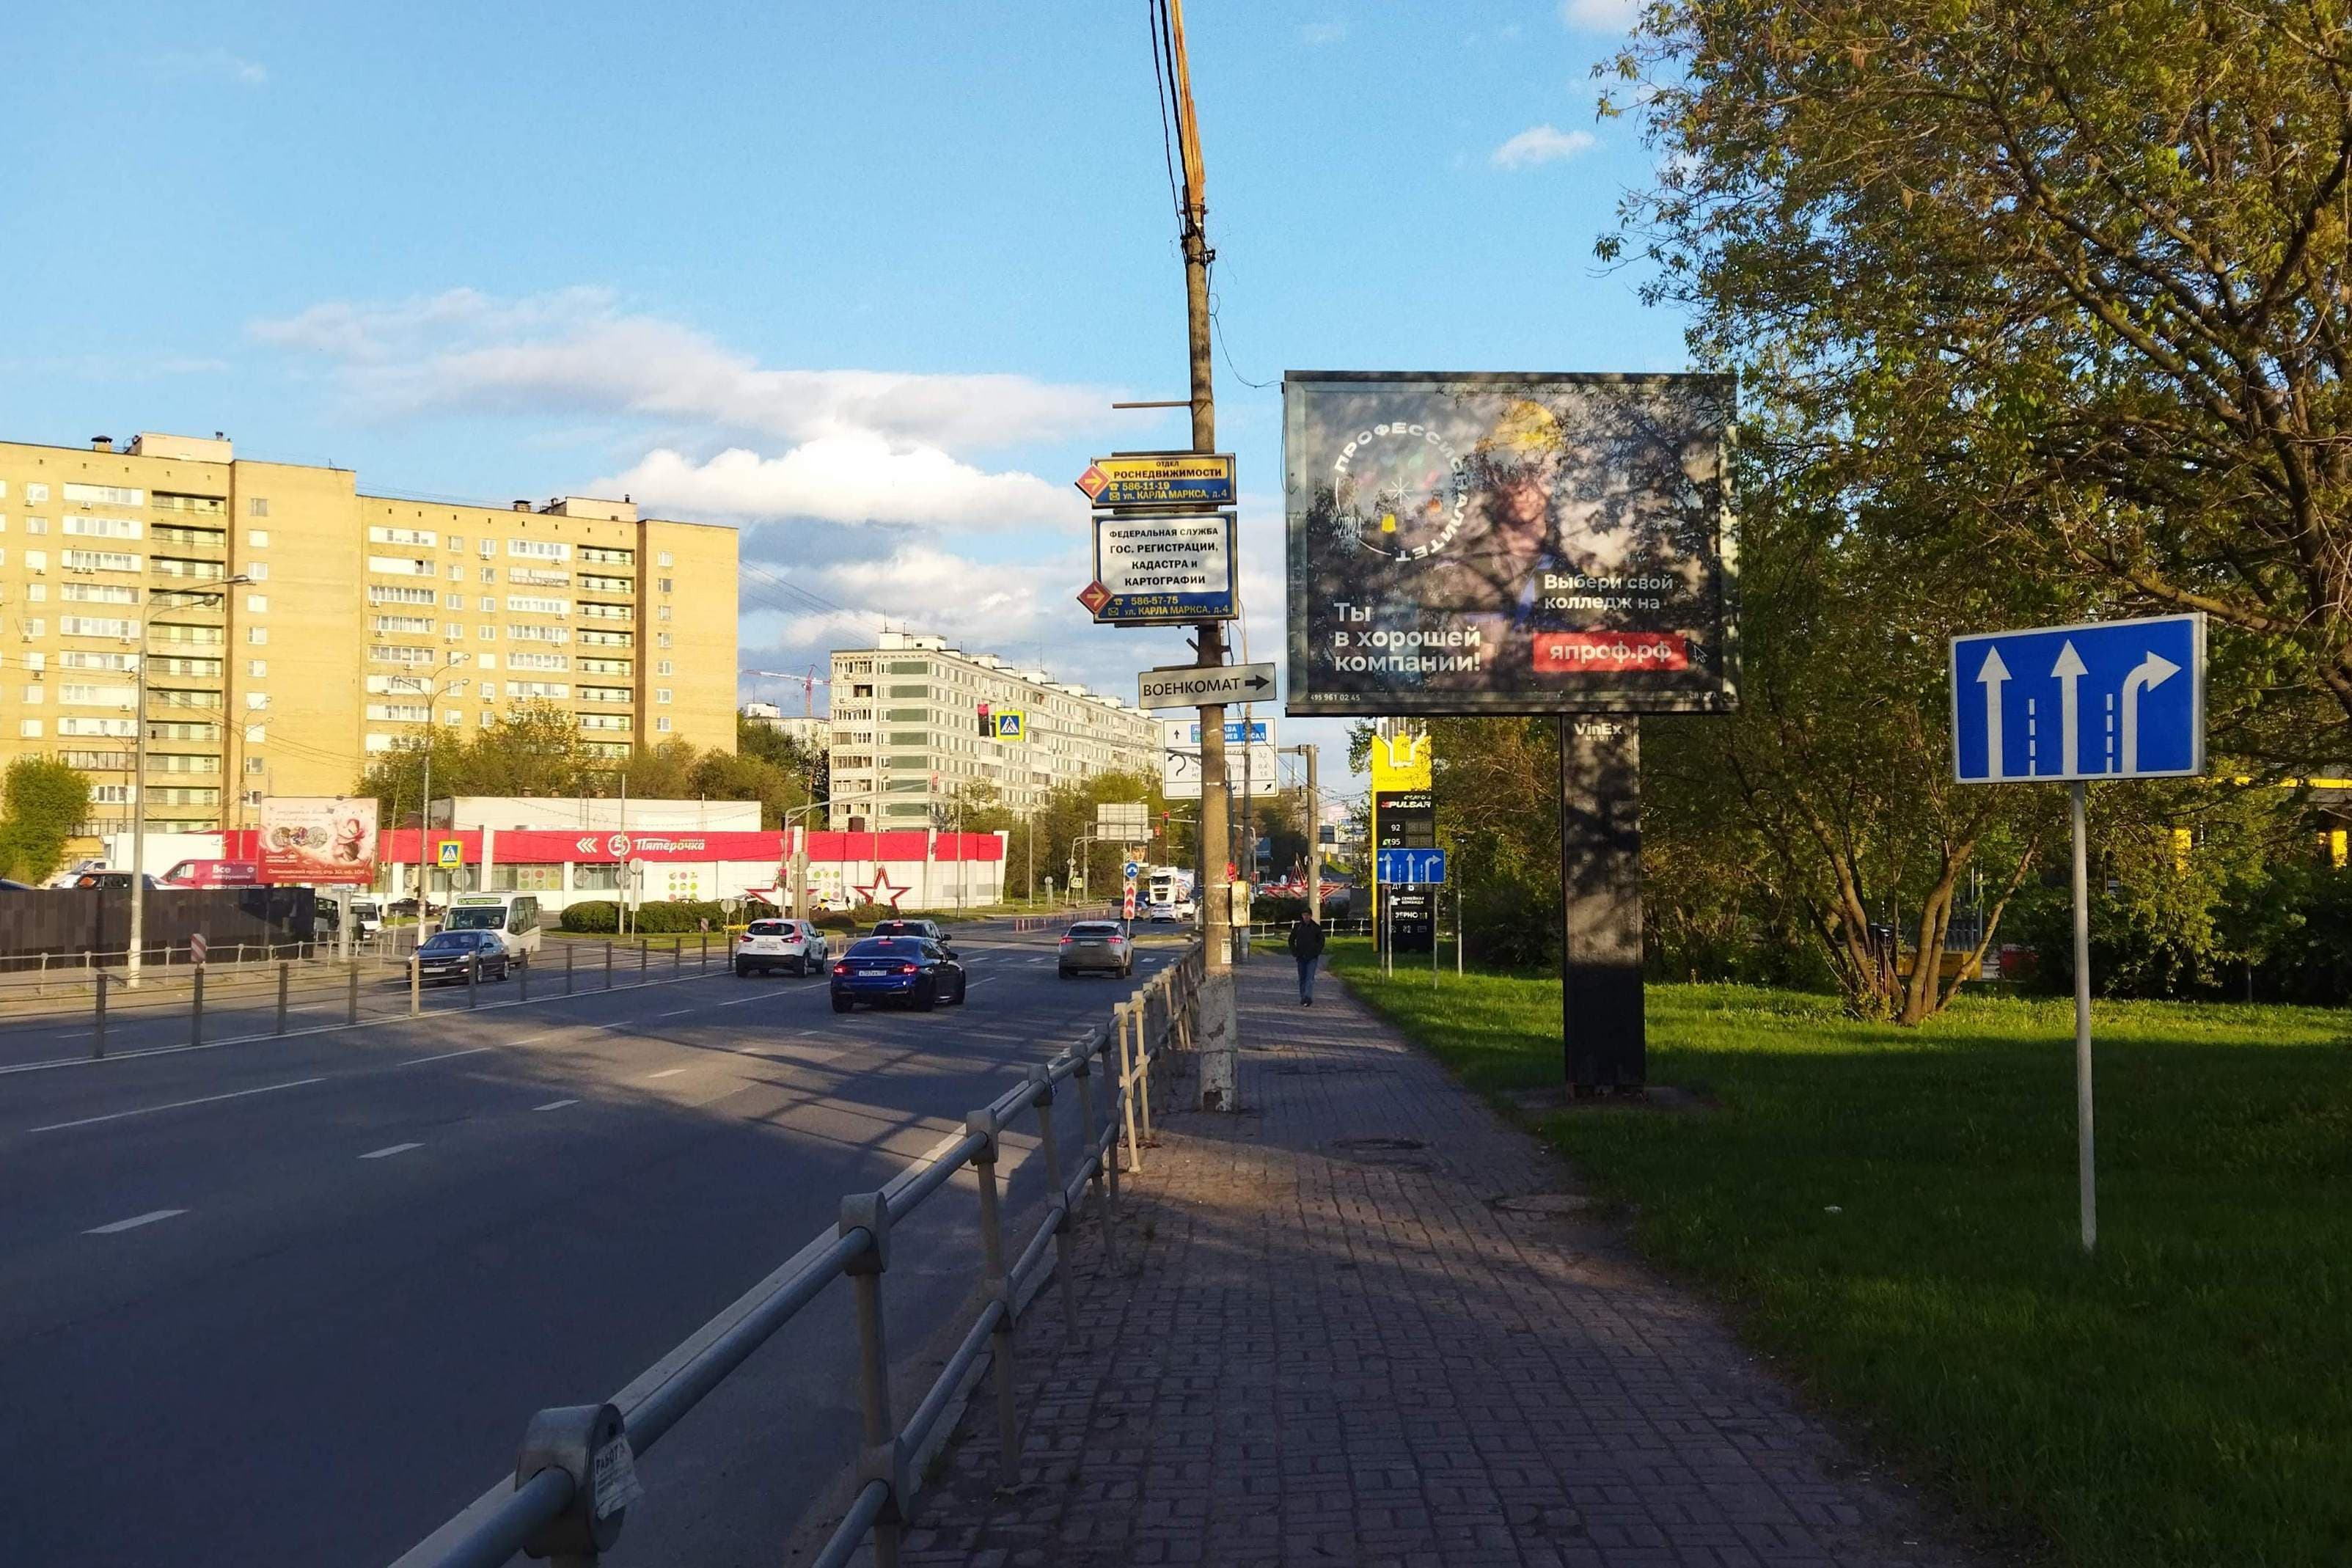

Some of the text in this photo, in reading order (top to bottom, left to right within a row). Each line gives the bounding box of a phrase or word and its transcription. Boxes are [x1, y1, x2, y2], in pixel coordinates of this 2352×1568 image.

[1113, 469, 1222, 479] РОСНЕДВИЖИМОСТИ
[1137, 490, 1168, 499] КАРЛА
[1168, 489, 1209, 499] МАРКСА,
[1335, 422, 1468, 562] ПРОФЕССИОНАЛИТЕТ
[1110, 527, 1218, 538] ФЕДЕРАЛЬНАЯ СЛУЖБА
[1338, 516, 1362, 538] 2024
[1110, 542, 1219, 554] ГОС. РЕГИСТРАЦИИ,
[1132, 560, 1188, 571] КАДАСТРА
[1124, 576, 1206, 586] КАРТОГРАФИИ
[1545, 574, 1674, 592] Выбери свой
[1130, 596, 1178, 605] 586-57-75
[1545, 596, 1660, 611] колледж на
[1138, 607, 1168, 615] КАРЛА
[1170, 605, 1211, 615] МАРКСА,
[1333, 602, 1371, 622] Ты
[1335, 626, 1481, 651] в хорошей
[1550, 640, 1672, 664] япроф.рф
[1335, 652, 1481, 672] компании!
[1143, 678, 1240, 696] ВОЕНКОМАТ
[1324, 693, 1337, 701] 961
[1574, 723, 1622, 735] VinEx
[1388, 800, 1432, 809] PULSAR
[1391, 824, 1401, 832] 92
[213, 864, 232, 873] Все
